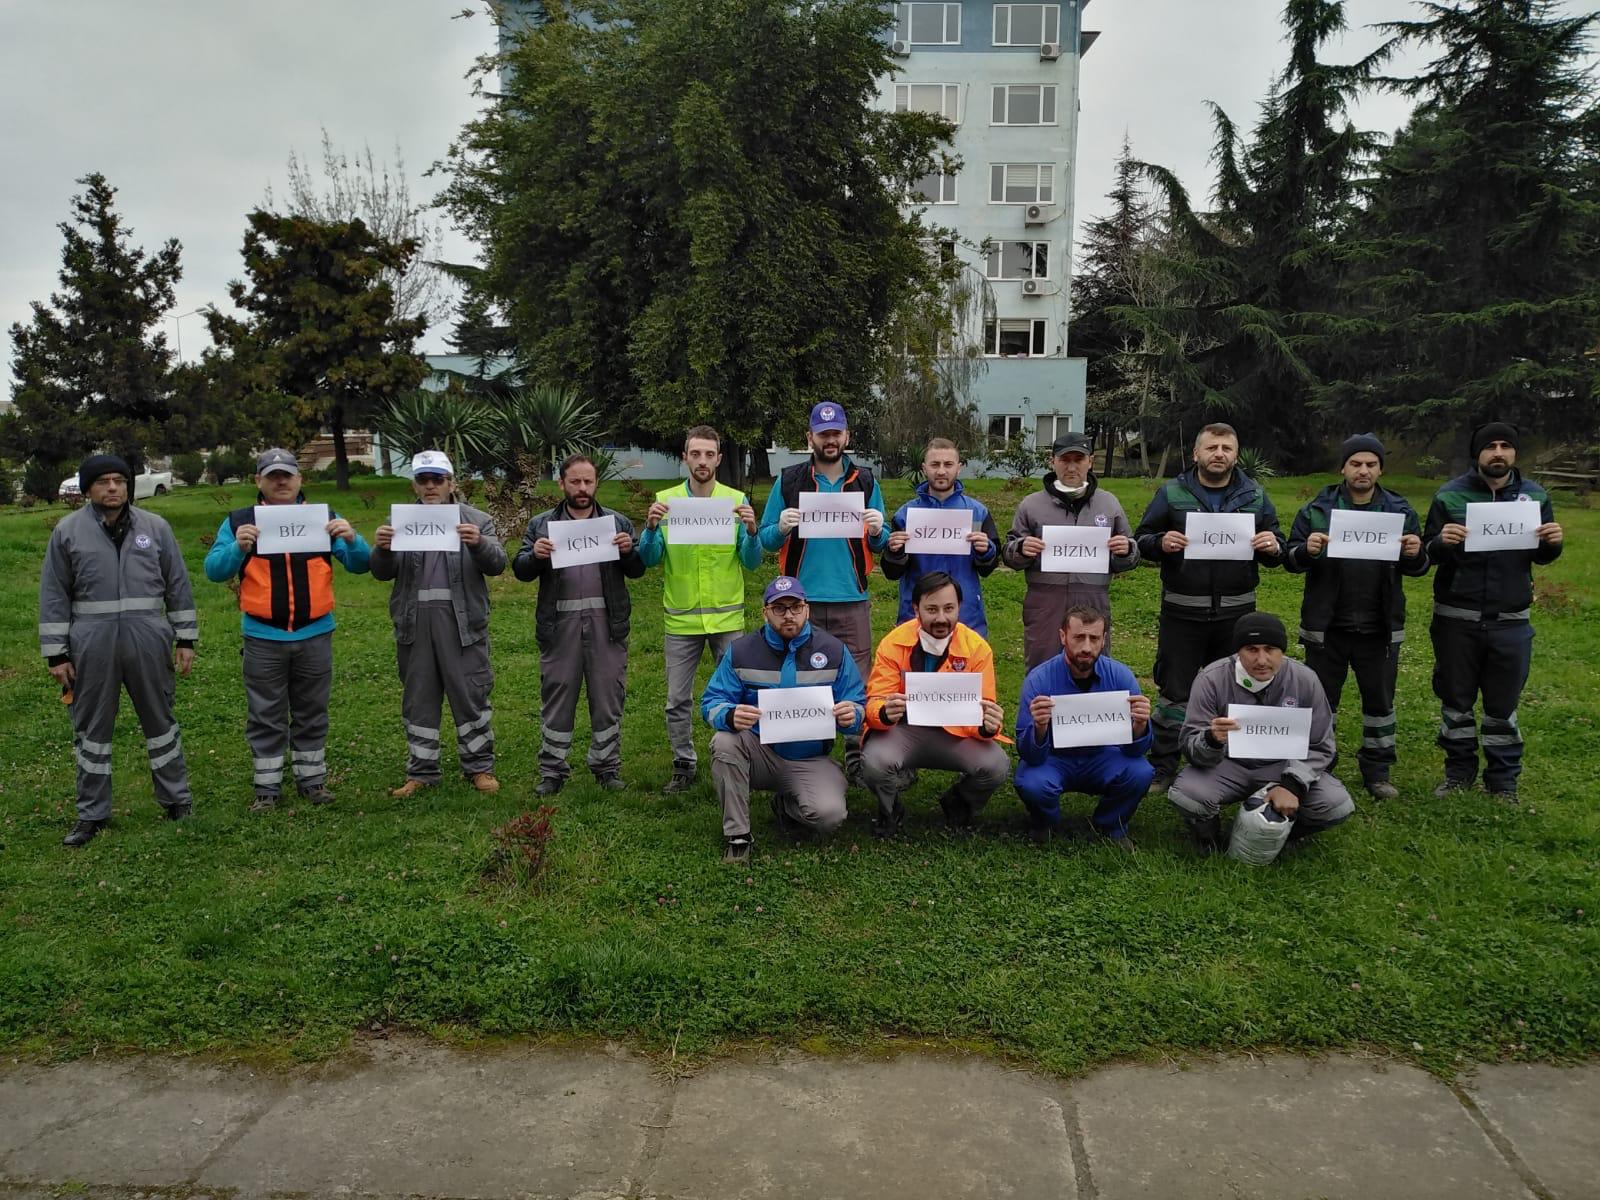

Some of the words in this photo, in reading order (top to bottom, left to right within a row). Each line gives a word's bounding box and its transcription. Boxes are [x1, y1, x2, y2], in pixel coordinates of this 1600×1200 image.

[670, 517, 732, 526] BURADAYIZ
[802, 509, 861, 523] LÜTFEN
[279, 522, 307, 538] BİZ
[404, 521, 446, 536] SİZİN
[914, 524, 938, 539] SİZ
[942, 527, 962, 540] DE
[1482, 522, 1524, 536] KAL!
[567, 535, 600, 552] İÇİN
[1202, 530, 1236, 547] İÇİN
[1342, 530, 1389, 545] EVDE
[1053, 543, 1097, 558] BİZİM
[908, 691, 978, 703] BÜYÜKŞEHİR
[766, 707, 826, 721] TRABZON
[1056, 711, 1126, 726] İLAÇLAMA
